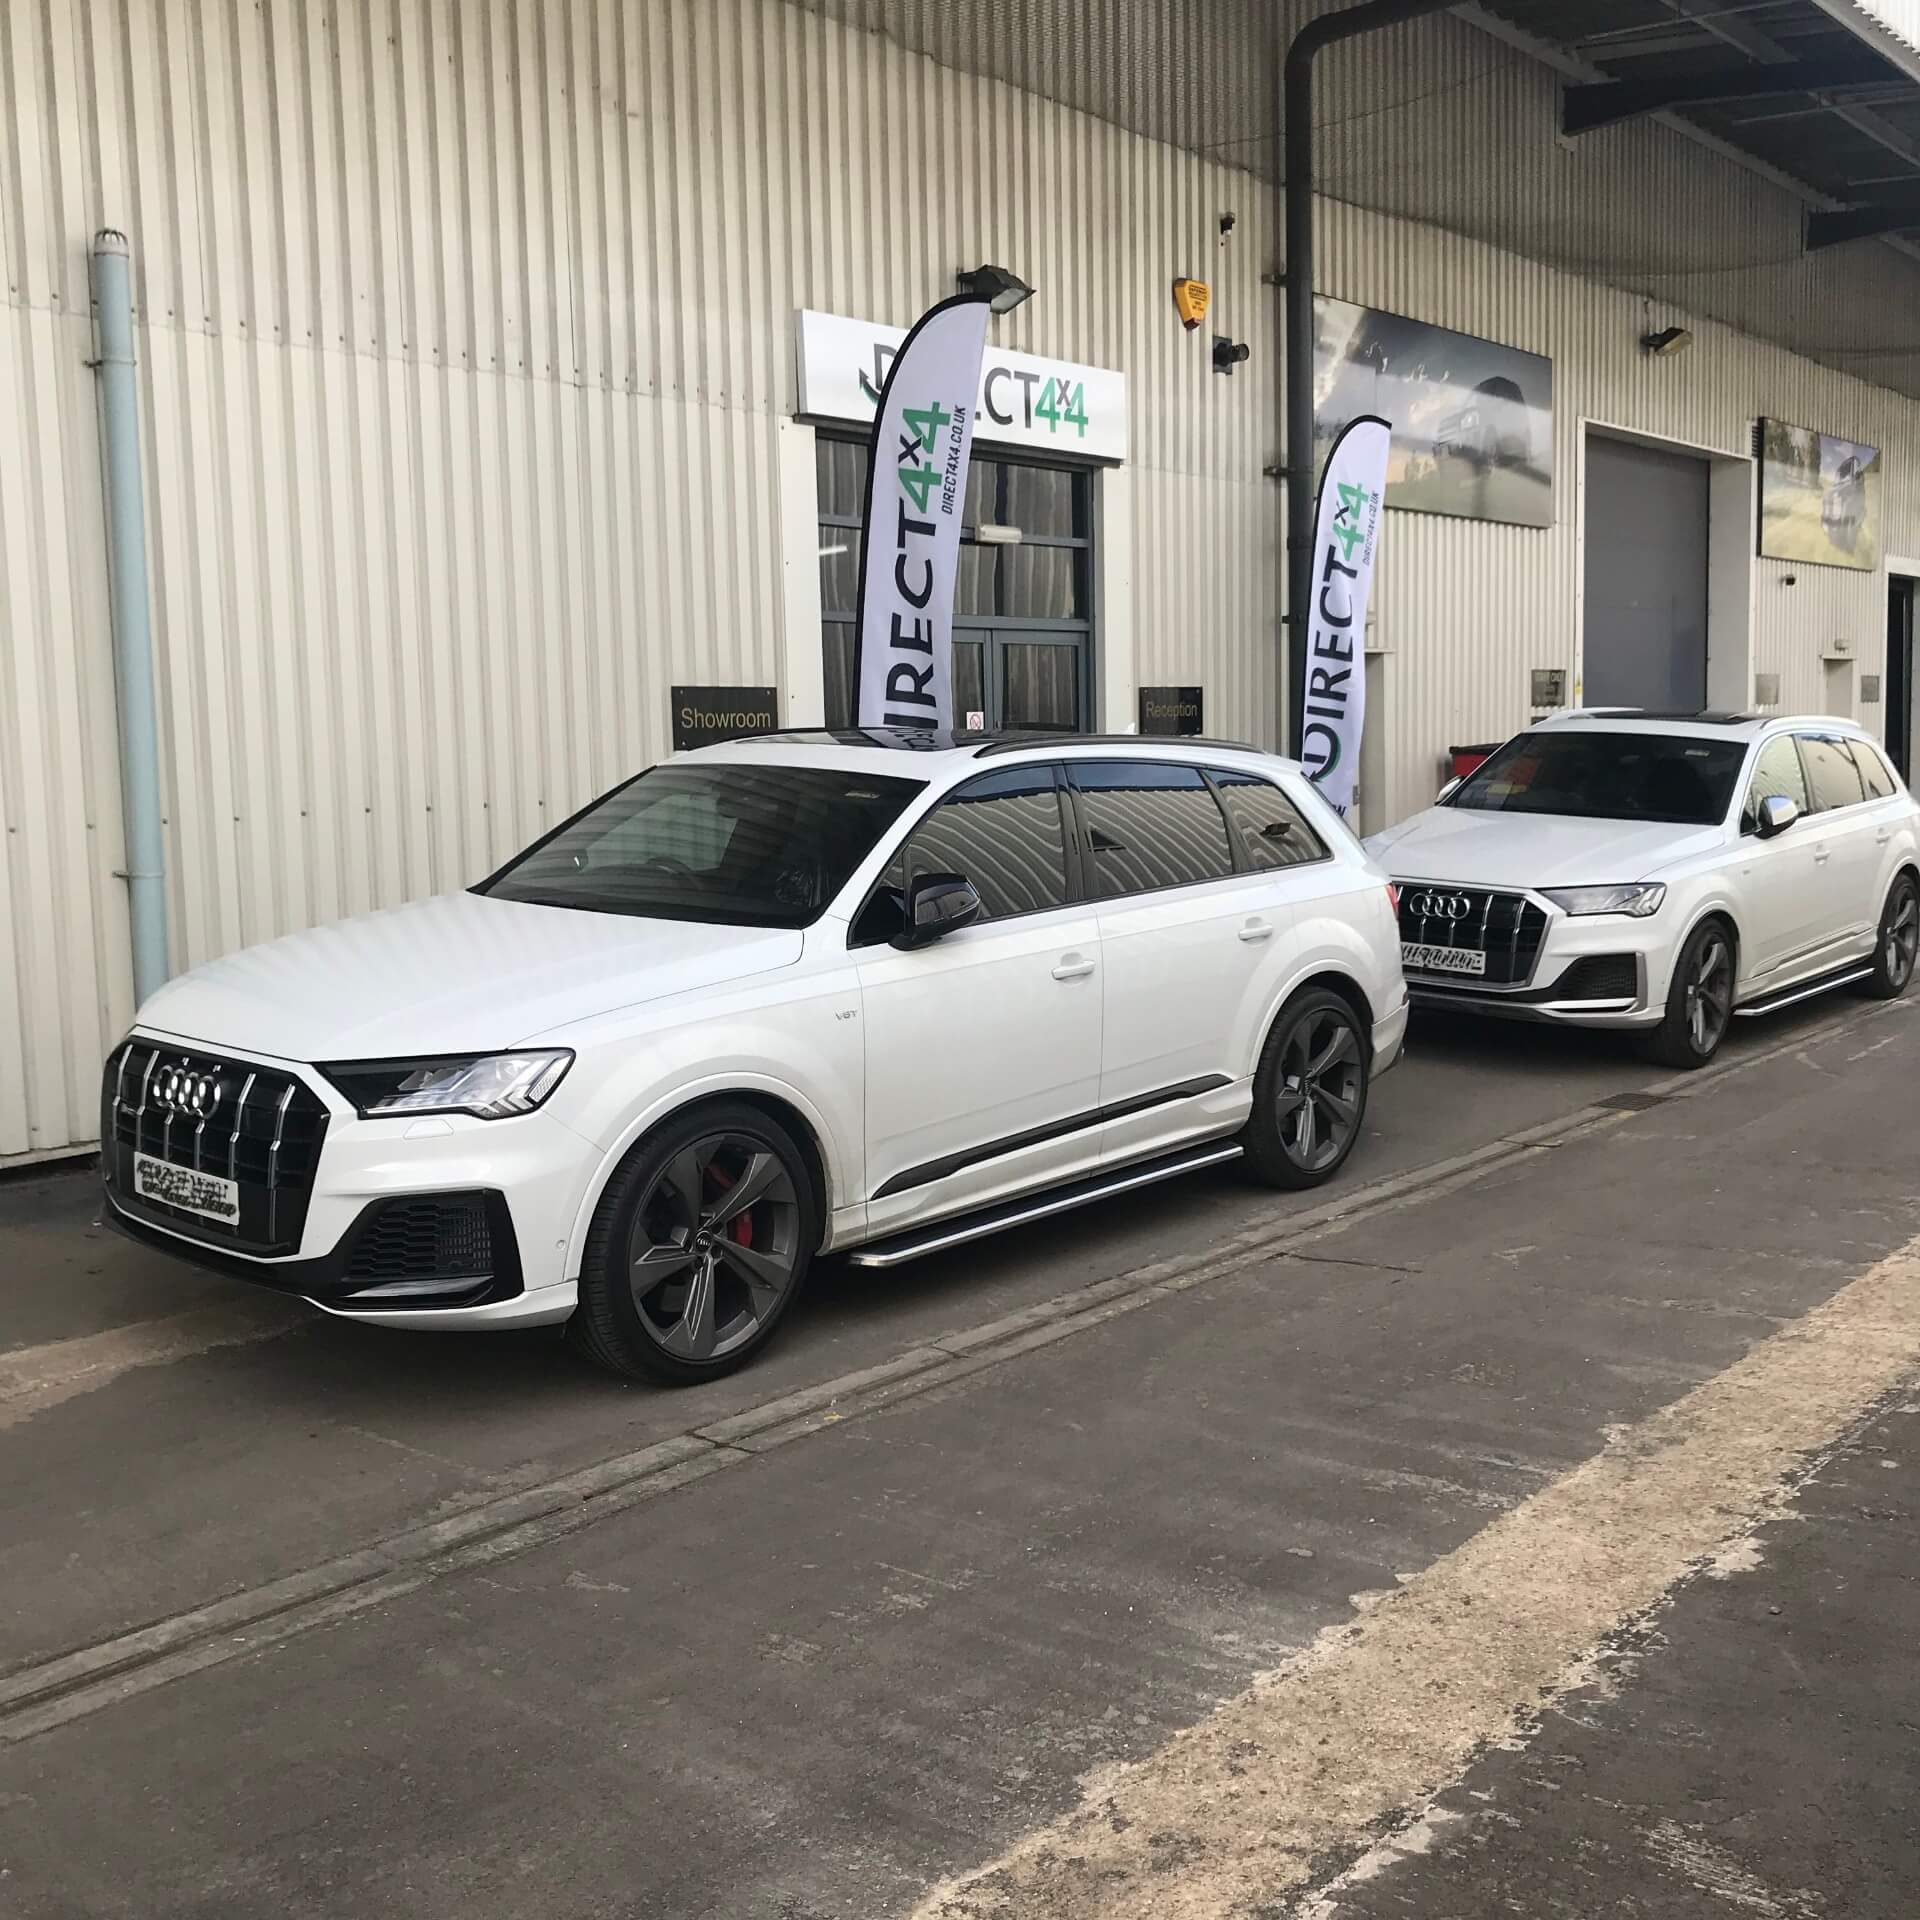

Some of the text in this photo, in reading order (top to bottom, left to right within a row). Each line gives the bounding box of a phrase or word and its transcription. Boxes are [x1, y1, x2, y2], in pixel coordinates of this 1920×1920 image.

[941, 405, 966, 514] DIRECT4X4.CO.UK
[681, 707, 771, 729] Showroom
[1145, 701, 1198, 720] Reception
